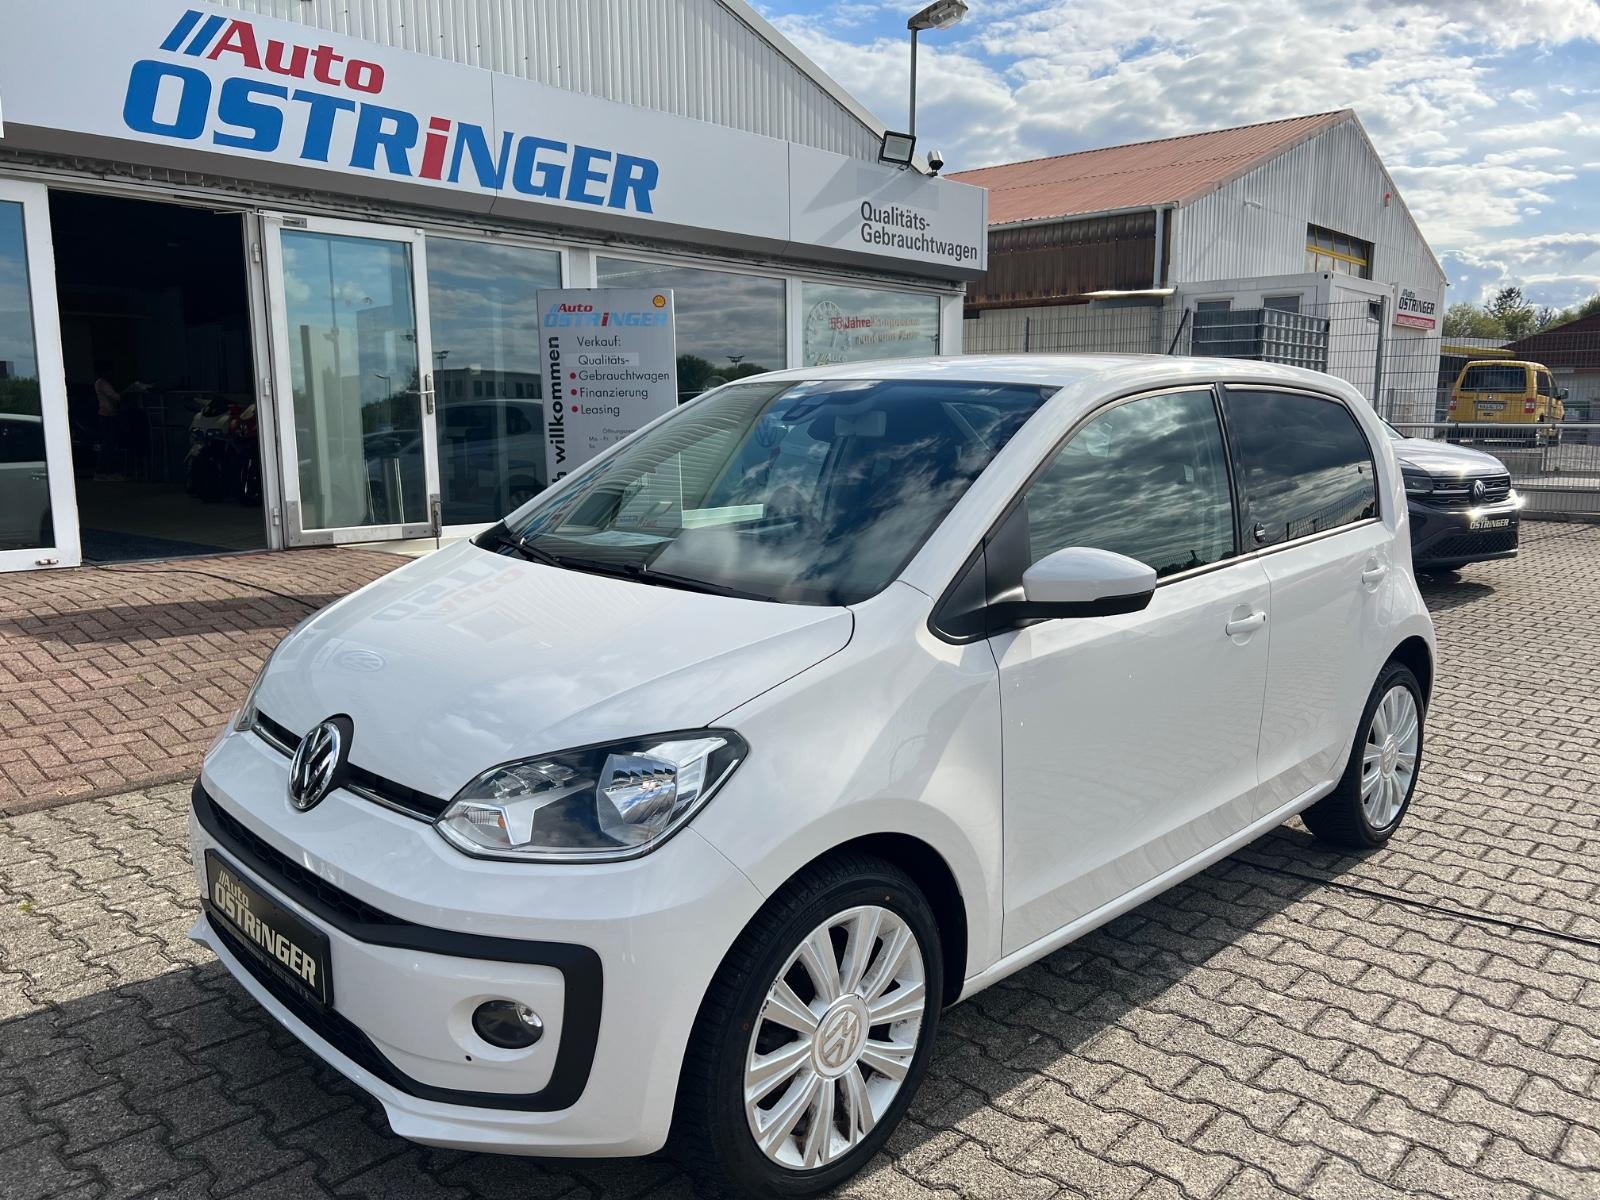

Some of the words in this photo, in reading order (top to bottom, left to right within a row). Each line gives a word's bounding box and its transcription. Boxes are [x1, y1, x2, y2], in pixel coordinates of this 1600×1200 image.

[207, 19, 385, 95] Auto
[860, 201, 931, 231] Qualitäts-
[861, 223, 978, 261] Gebrauchtwagen
[557, 303, 593, 313] Auto
[845, 316, 871, 329] Jahre
[576, 335, 622, 347] Verkauf:
[578, 355, 630, 366] Qualitäts-
[578, 370, 670, 383] Gebrauchtwagen
[548, 336, 567, 464] willkommen
[580, 387, 649, 400] Finanzierung
[581, 404, 620, 417] Leasing
[289, 721, 341, 810] VW
[223, 875, 250, 907] Auto
